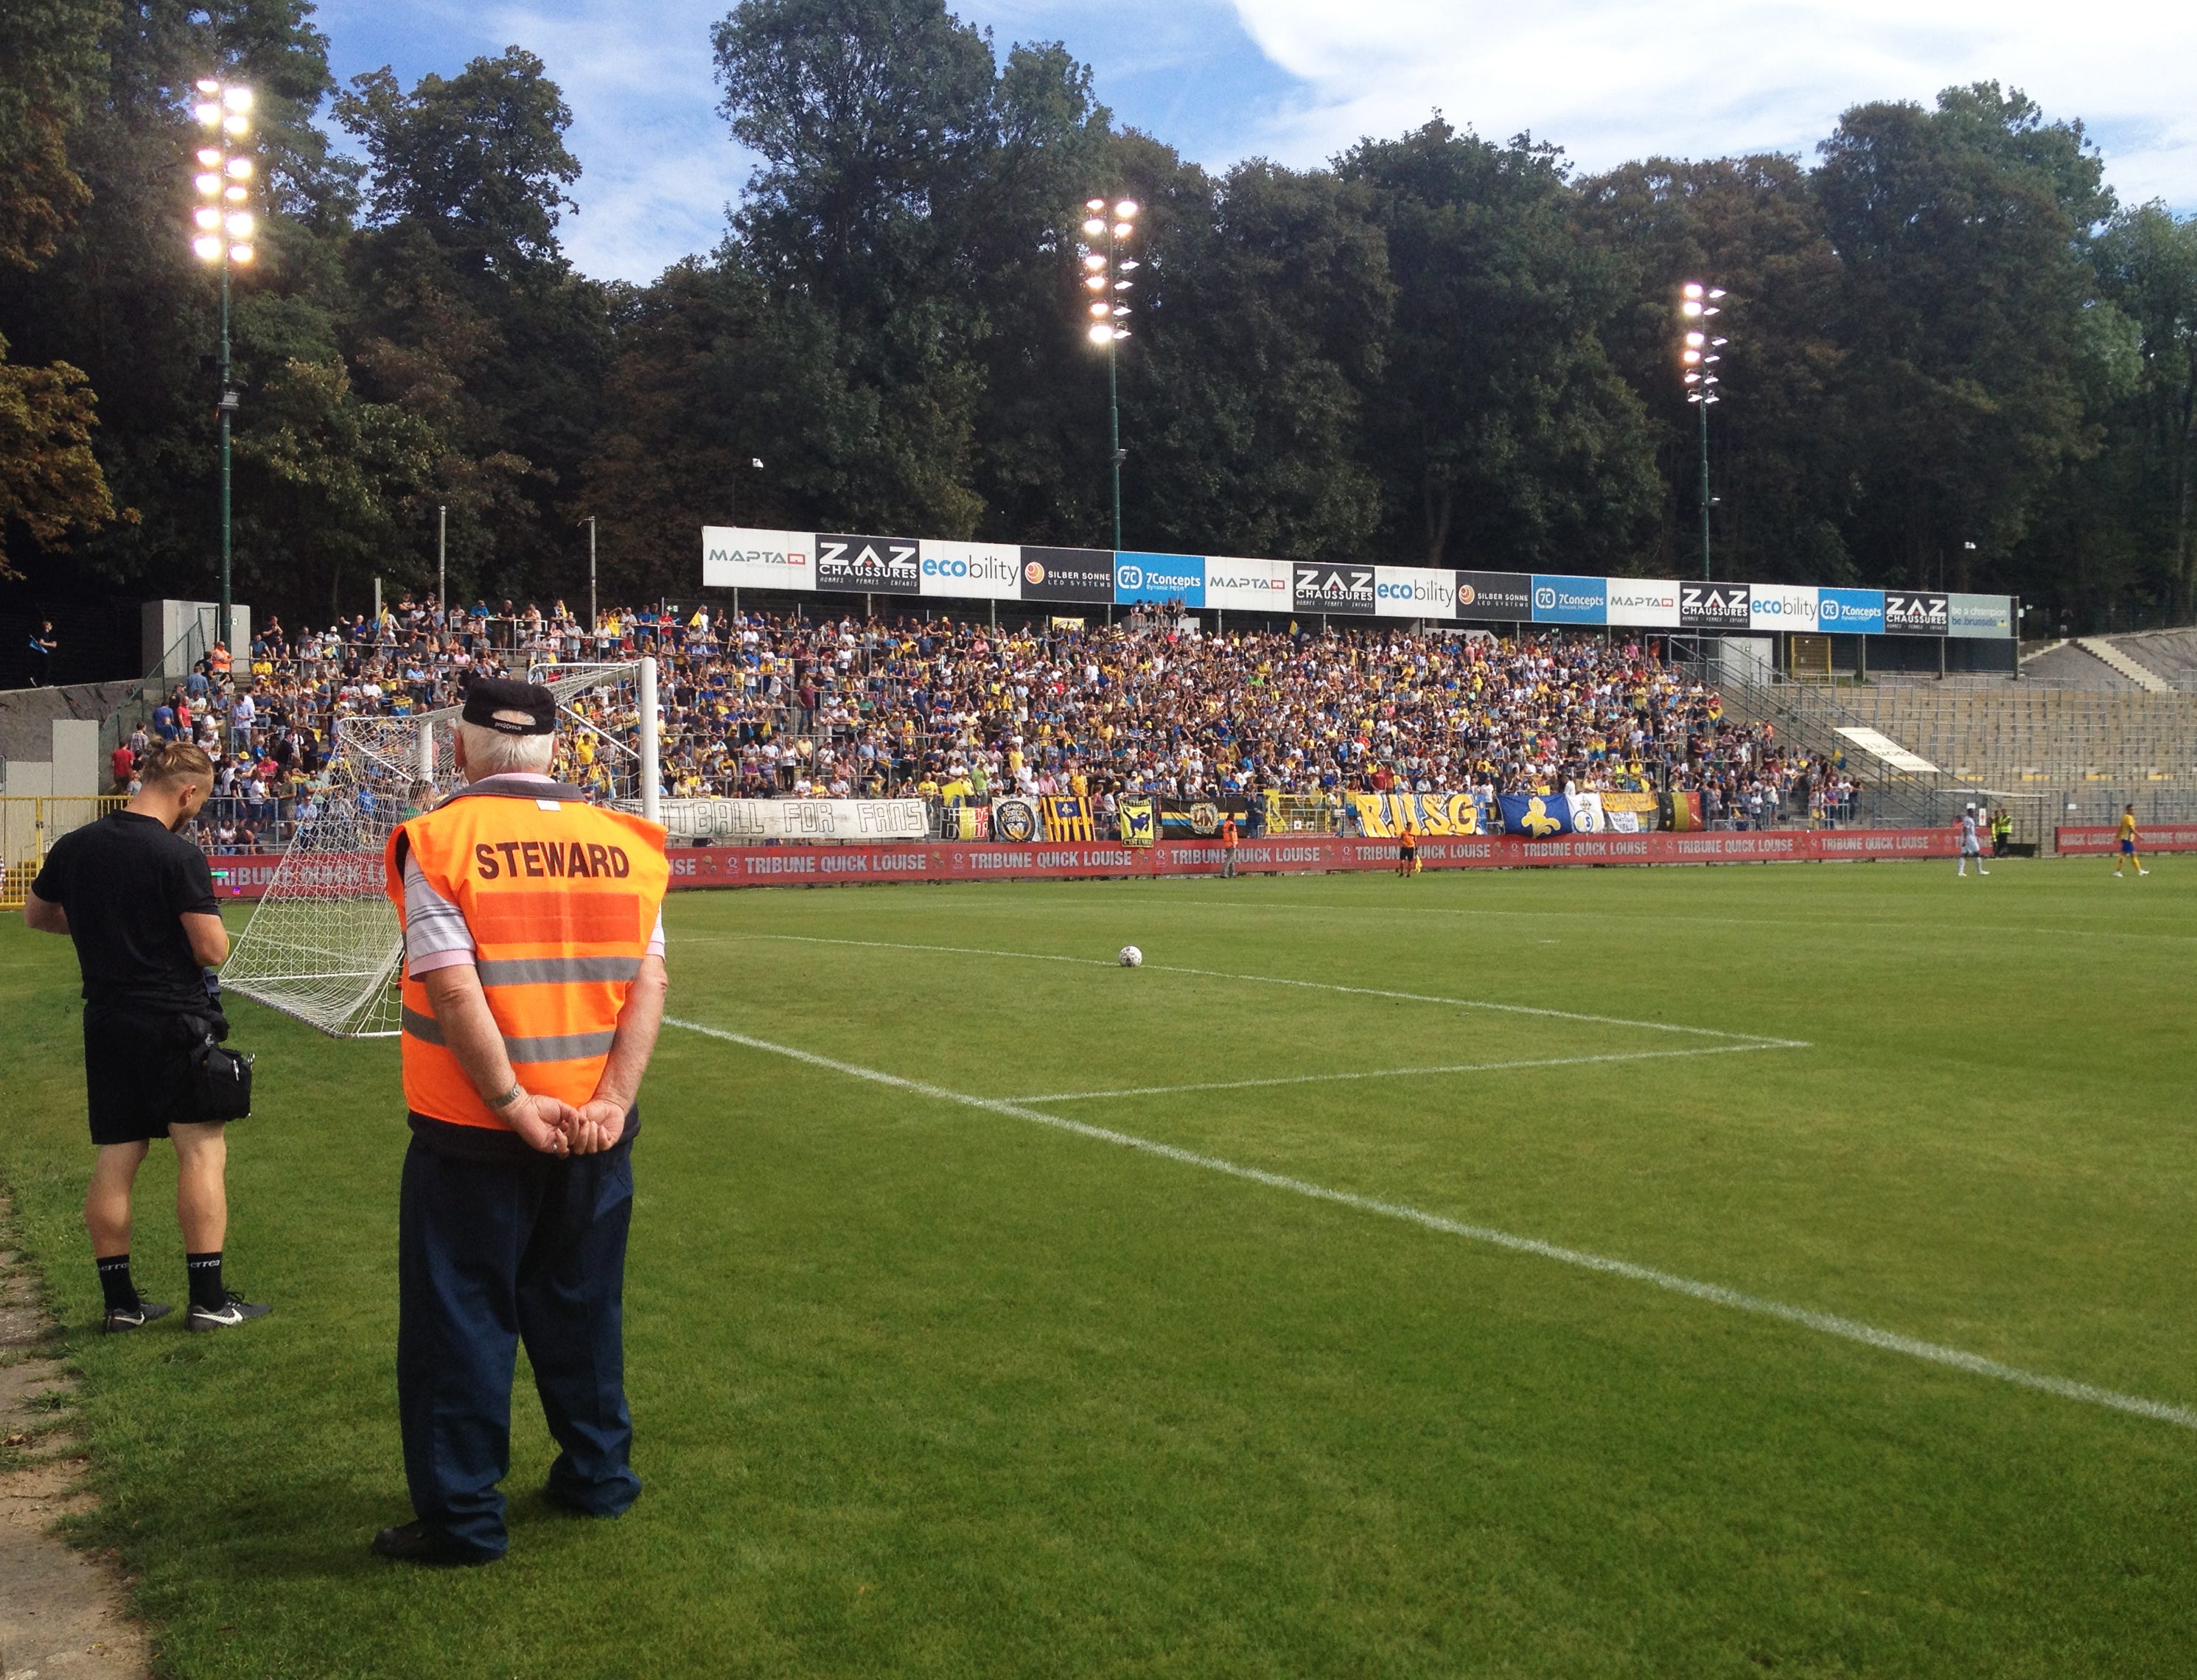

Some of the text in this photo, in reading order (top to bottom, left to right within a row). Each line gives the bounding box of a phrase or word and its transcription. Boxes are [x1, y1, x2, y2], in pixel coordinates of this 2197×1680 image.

[819, 542, 917, 570] ZAZ
[819, 564, 917, 579] CHAUSSURES
[922, 555, 1020, 587] ecobility
[1047, 570, 1111, 581] SILBER SONNE
[1069, 581, 1111, 589] SYSTEMS
[1146, 573, 1201, 589] 7Concepts
[1296, 570, 1373, 592] ZAZ
[1296, 589, 1374, 601] CHAUSSURES
[1377, 579, 1456, 608] ecobility
[1477, 592, 1529, 602] SILBER SONNE
[1558, 594, 1604, 609] 7Concepts
[1682, 589, 1748, 609] ZAZ
[1682, 606, 1748, 617] CHAUSSURES
[1751, 595, 1817, 621] ecobility
[1841, 605, 1882, 618] 7Concepts
[1886, 598, 1947, 617] ZAZ
[1952, 605, 1961, 615] be
[1970, 606, 2007, 617] champion
[1886, 615, 1947, 625] CHAUSSURES
[660, 801, 924, 833] TBALL FOR FANS
[1355, 845, 1401, 861] TRIBUN
[1450, 843, 1490, 858] LOUISE
[1523, 841, 1647, 858] TRIBUNE QUICK LOUISE
[1677, 837, 1793, 854] TRIBUNE QUICK LOUISE
[1820, 836, 1929, 851] TRIBUNE QUICK LOUISE
[475, 841, 630, 880] STEWARD
[744, 853, 926, 874] TRIBUNE QUICK LOUISE
[969, 850, 1132, 869] TRIBUNE QUICK LOUISE
[1171, 847, 1320, 865] TRIBUNE QUICK LOUISE
